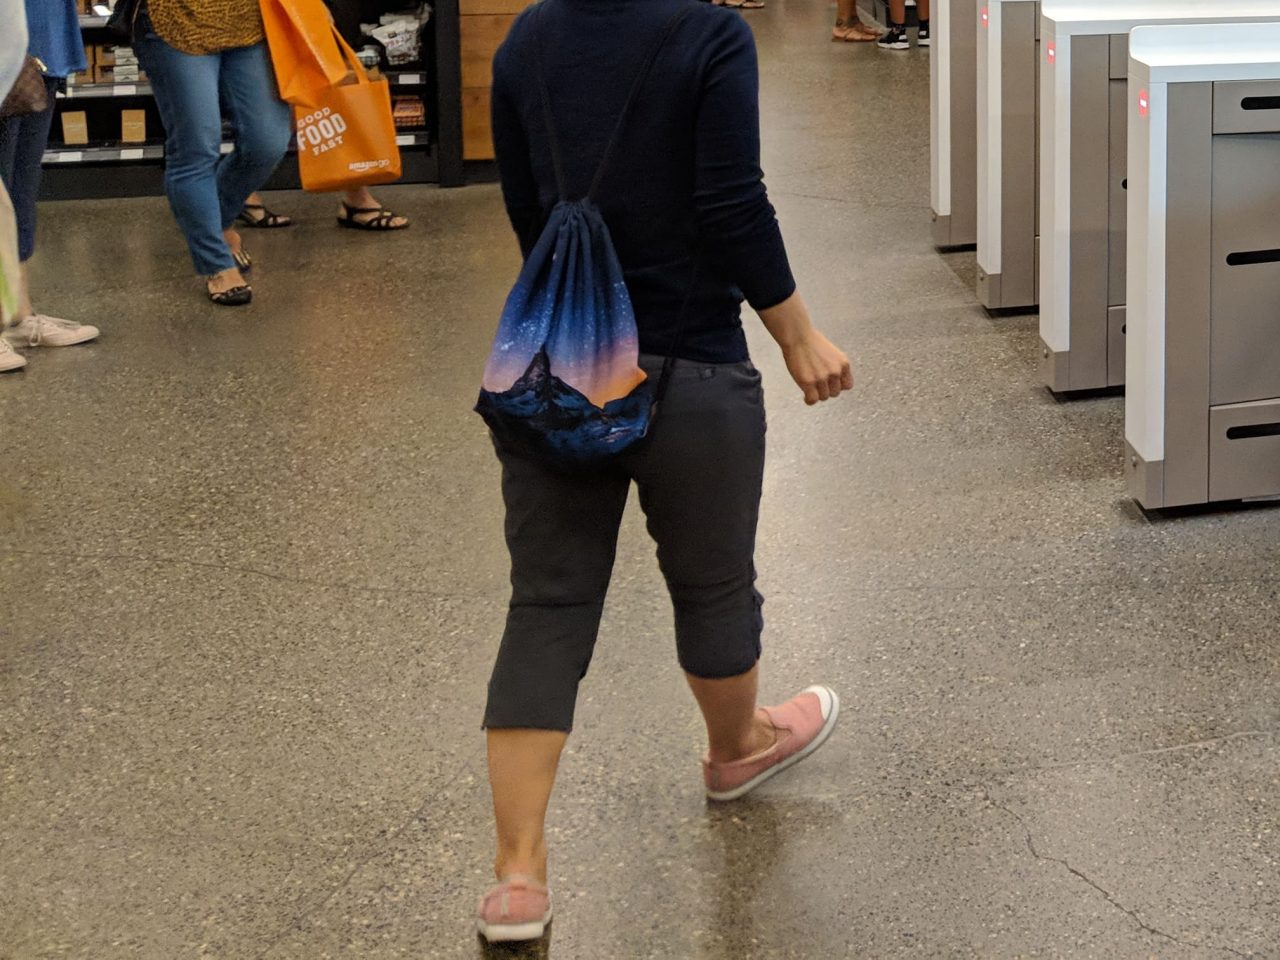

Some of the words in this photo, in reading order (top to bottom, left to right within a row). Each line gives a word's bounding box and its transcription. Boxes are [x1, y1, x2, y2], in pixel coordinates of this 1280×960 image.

[297, 107, 331, 128] GOOD
[297, 113, 348, 151] FOOD
[312, 135, 344, 156] FAST
